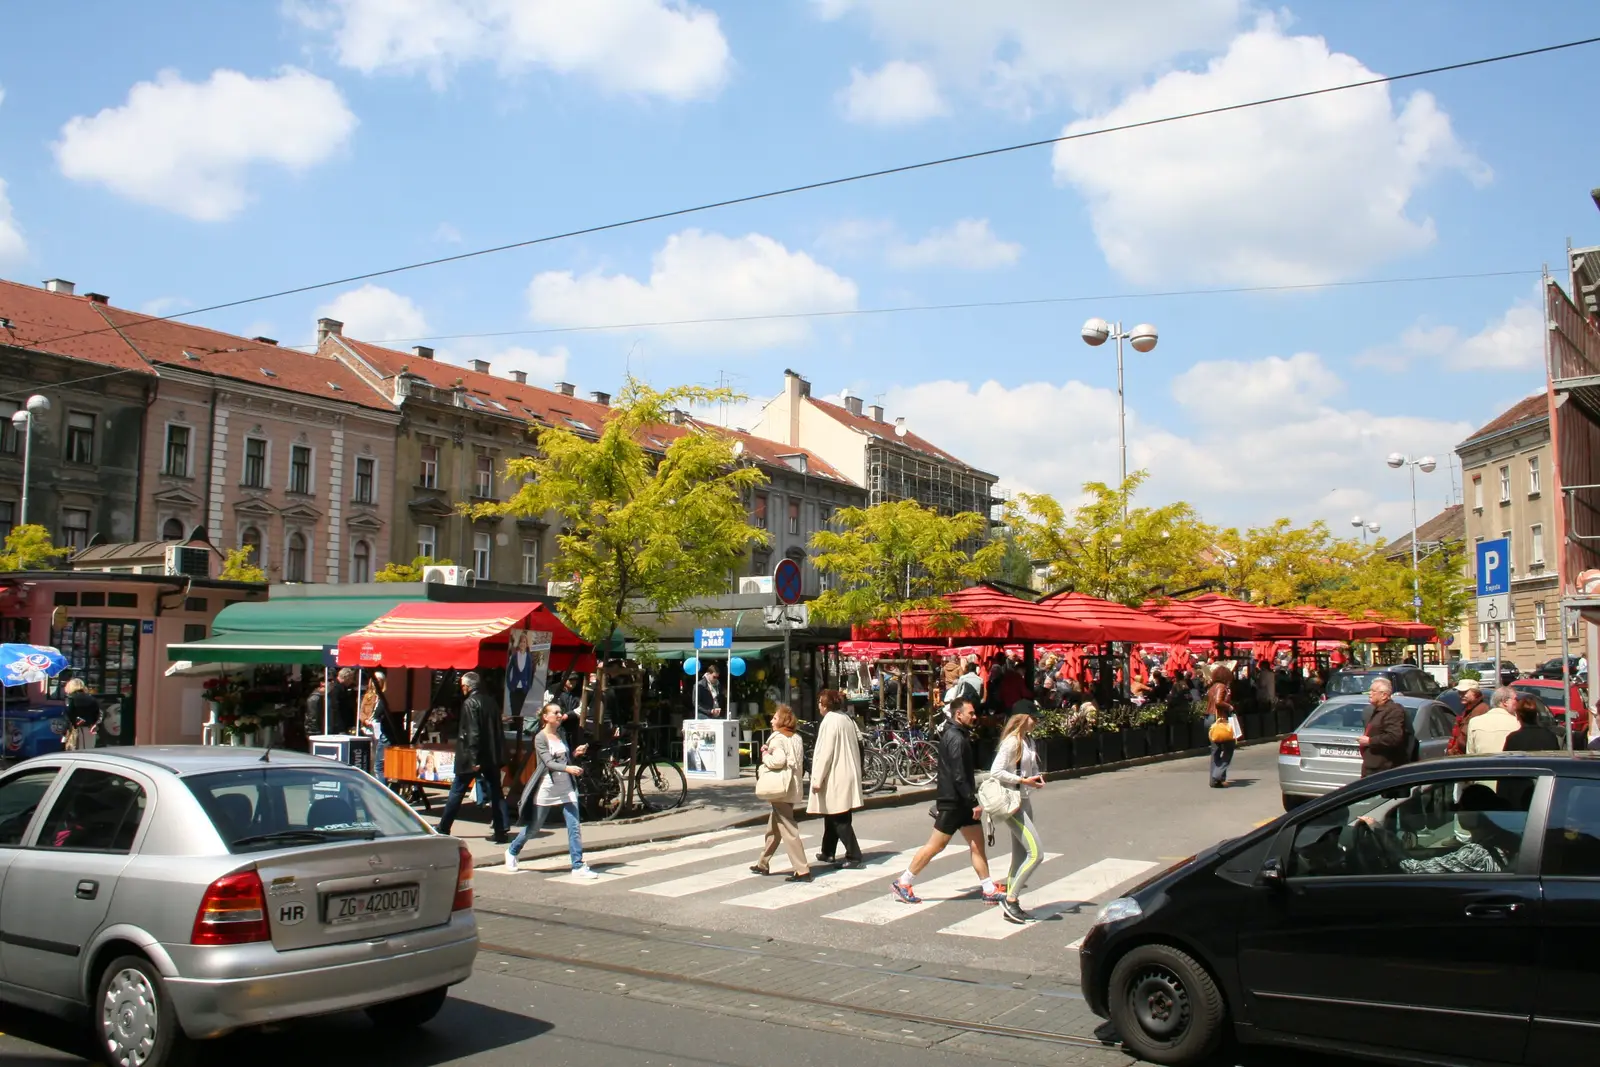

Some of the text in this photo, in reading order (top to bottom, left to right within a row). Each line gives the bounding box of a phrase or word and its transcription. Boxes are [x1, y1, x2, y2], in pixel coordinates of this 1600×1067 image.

[1485, 551, 1499, 584] P
[702, 628, 724, 638] Zagreb
[701, 638, 708, 649] je
[280, 905, 304, 921] HR
[339, 897, 357, 916] ZG
